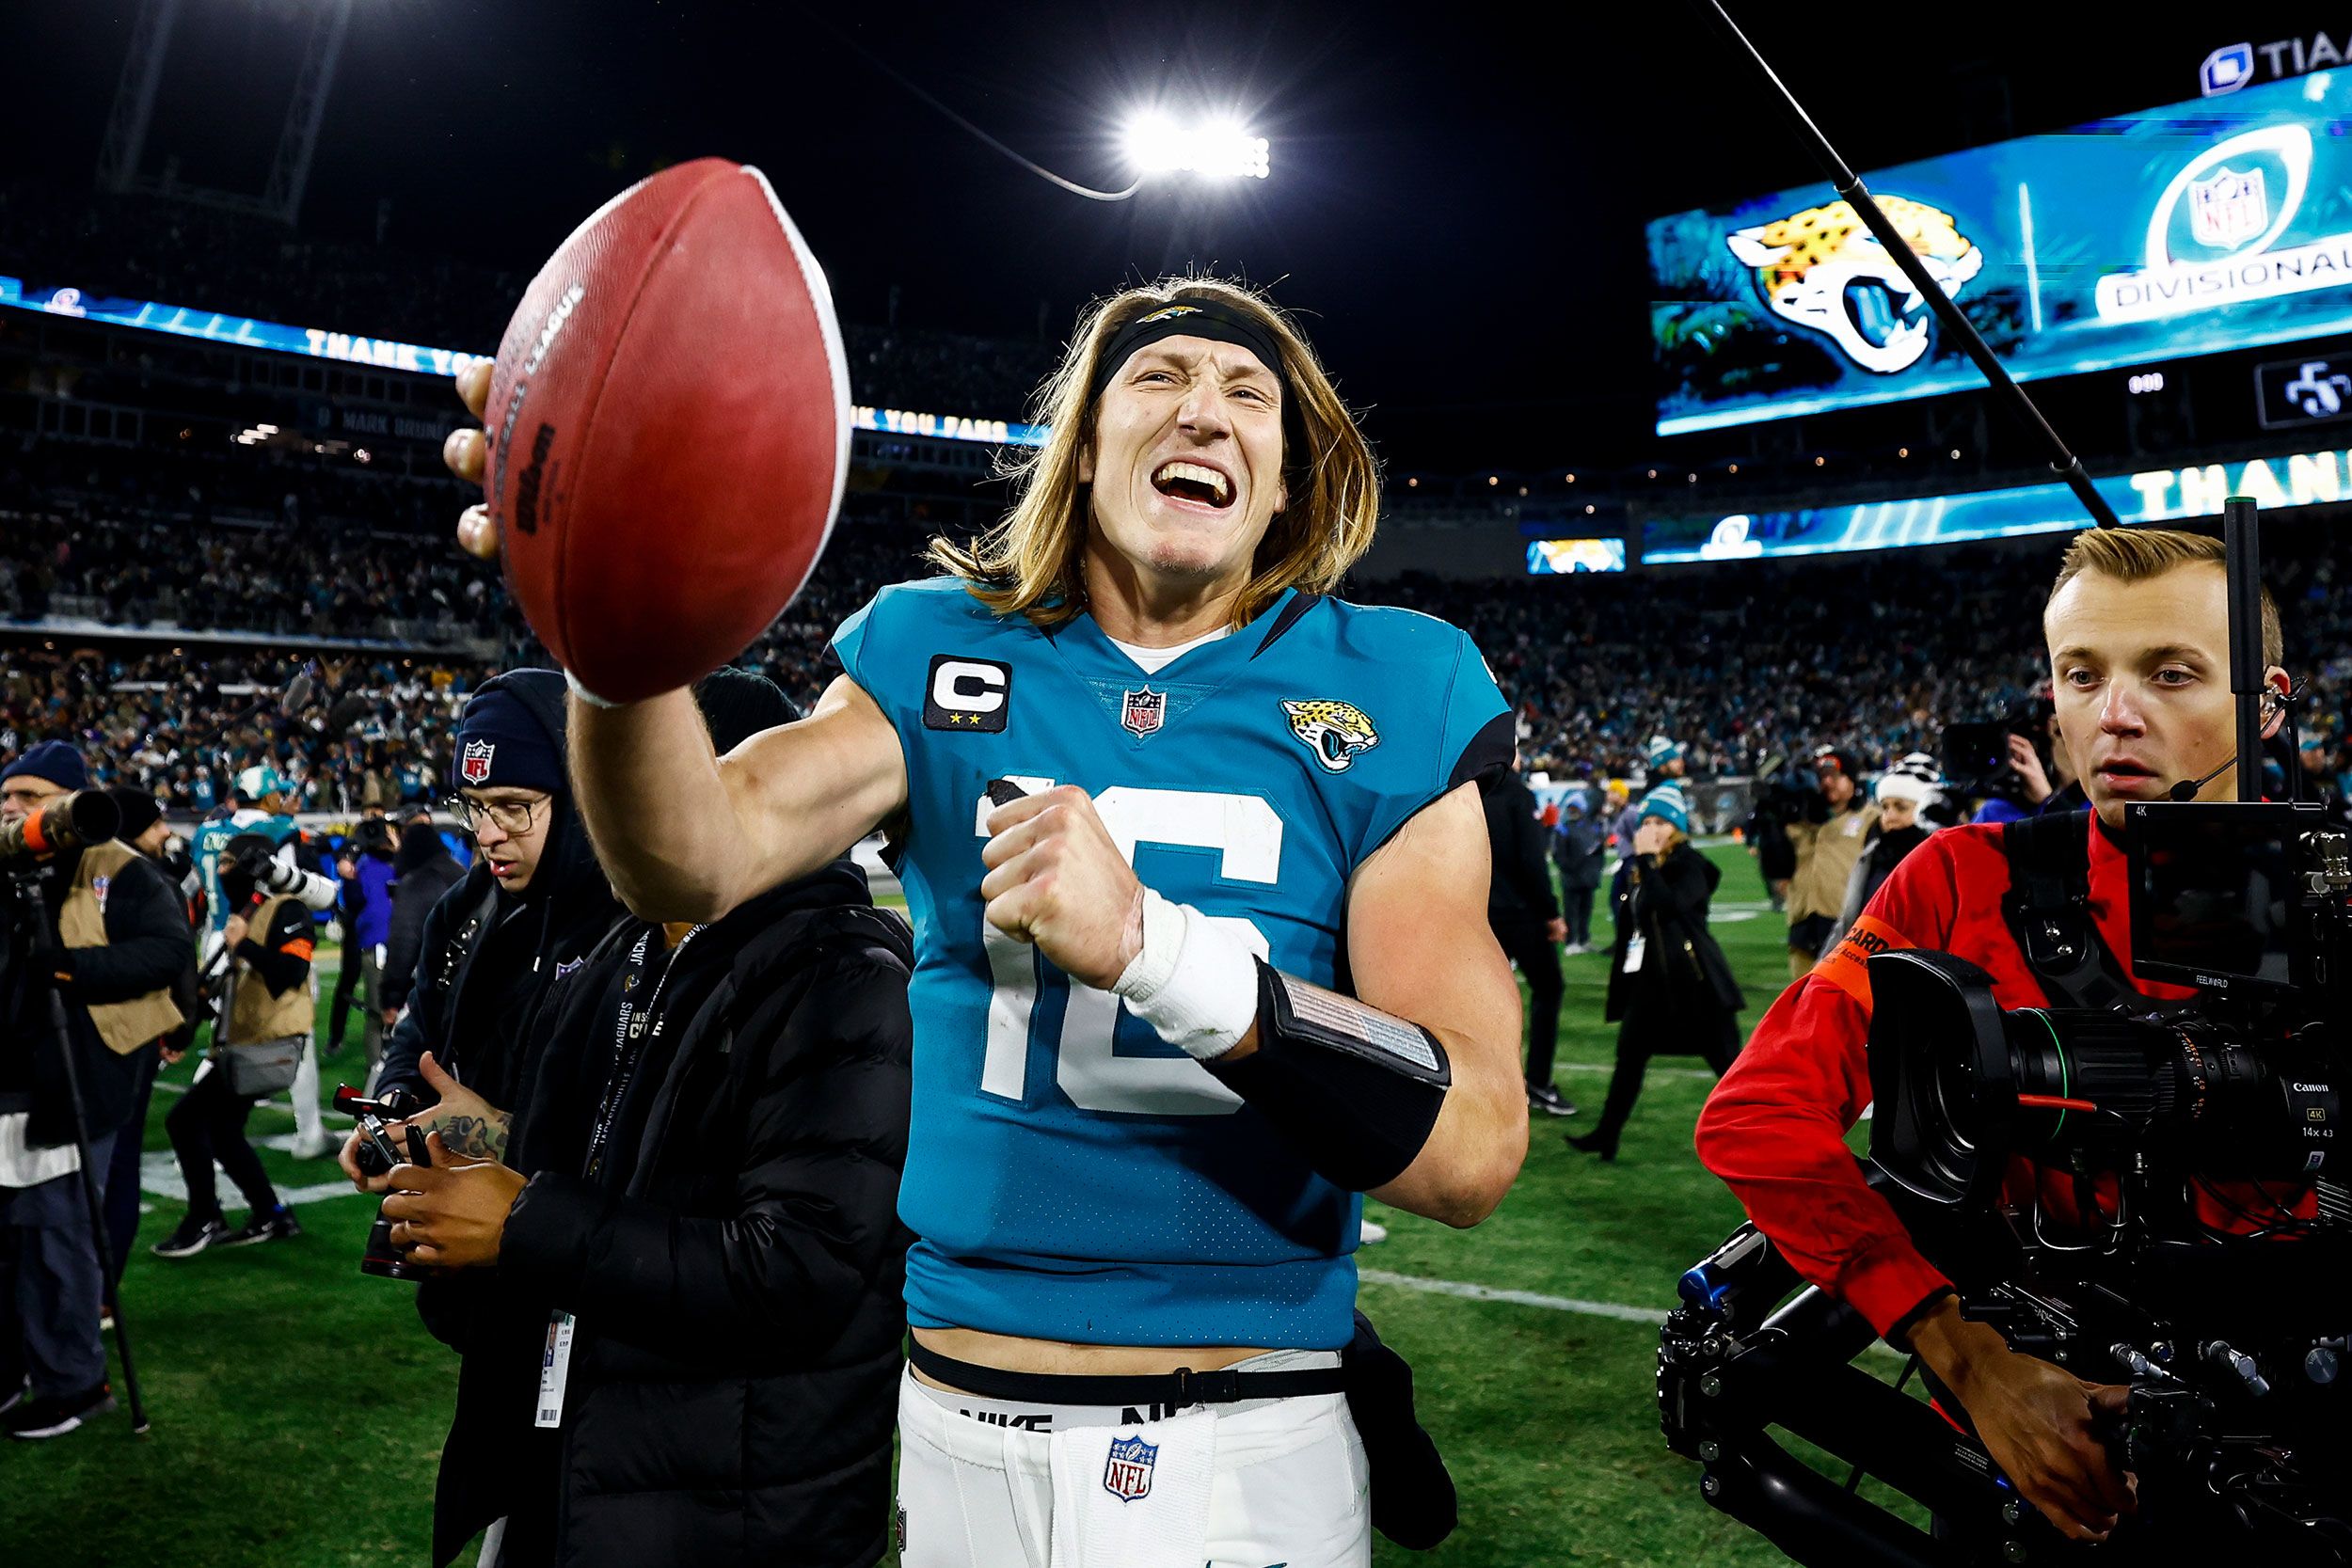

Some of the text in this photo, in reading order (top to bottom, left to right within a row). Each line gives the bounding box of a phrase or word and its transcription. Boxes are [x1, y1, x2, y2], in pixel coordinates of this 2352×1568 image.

[2205, 200, 2253, 235] NFL
[2116, 249, 2352, 308] DIVISIONAL
[305, 328, 420, 372] THANK
[884, 408, 936, 436] YOU
[943, 415, 1009, 443] FANS
[2130, 449, 2352, 521] THAN
[933, 661, 1006, 713] C
[1128, 707, 1159, 729] NFL
[2136, 805, 2147, 816] 4K
[975, 774, 1286, 1117] 16
[2196, 974, 2229, 989] FEELWORLD
[615, 1001, 633, 1053] JAGUARS
[2293, 1083, 2329, 1093] Canon
[2310, 1110, 2324, 1119] 4K
[1108, 1463, 1152, 1496] NFL
